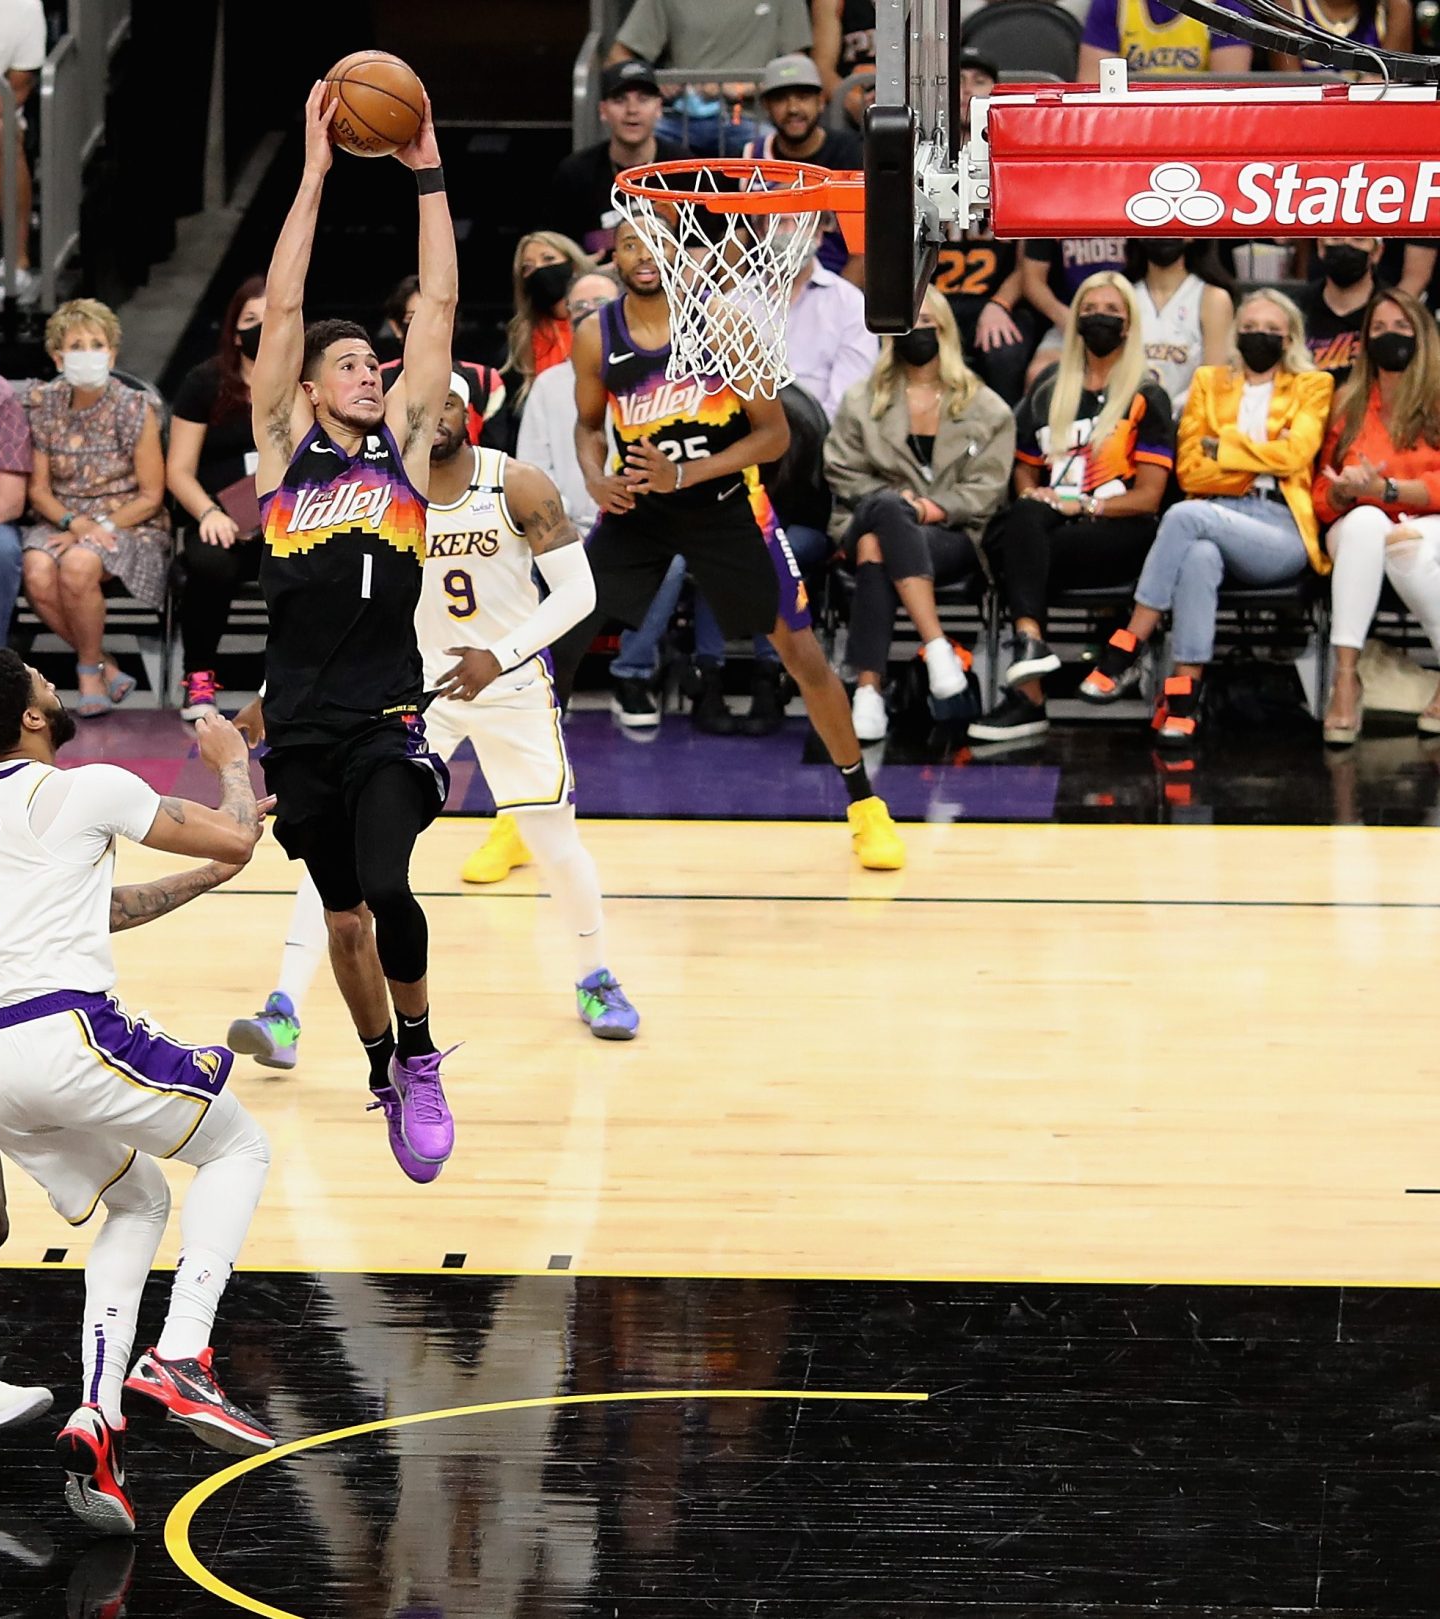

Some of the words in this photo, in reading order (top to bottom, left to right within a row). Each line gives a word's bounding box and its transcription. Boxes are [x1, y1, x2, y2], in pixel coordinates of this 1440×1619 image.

[1232, 162, 1406, 226] State
[935, 248, 997, 294] 22
[286, 480, 392, 533] Valley
[361, 553, 372, 599] 1
[443, 568, 478, 620] 9
